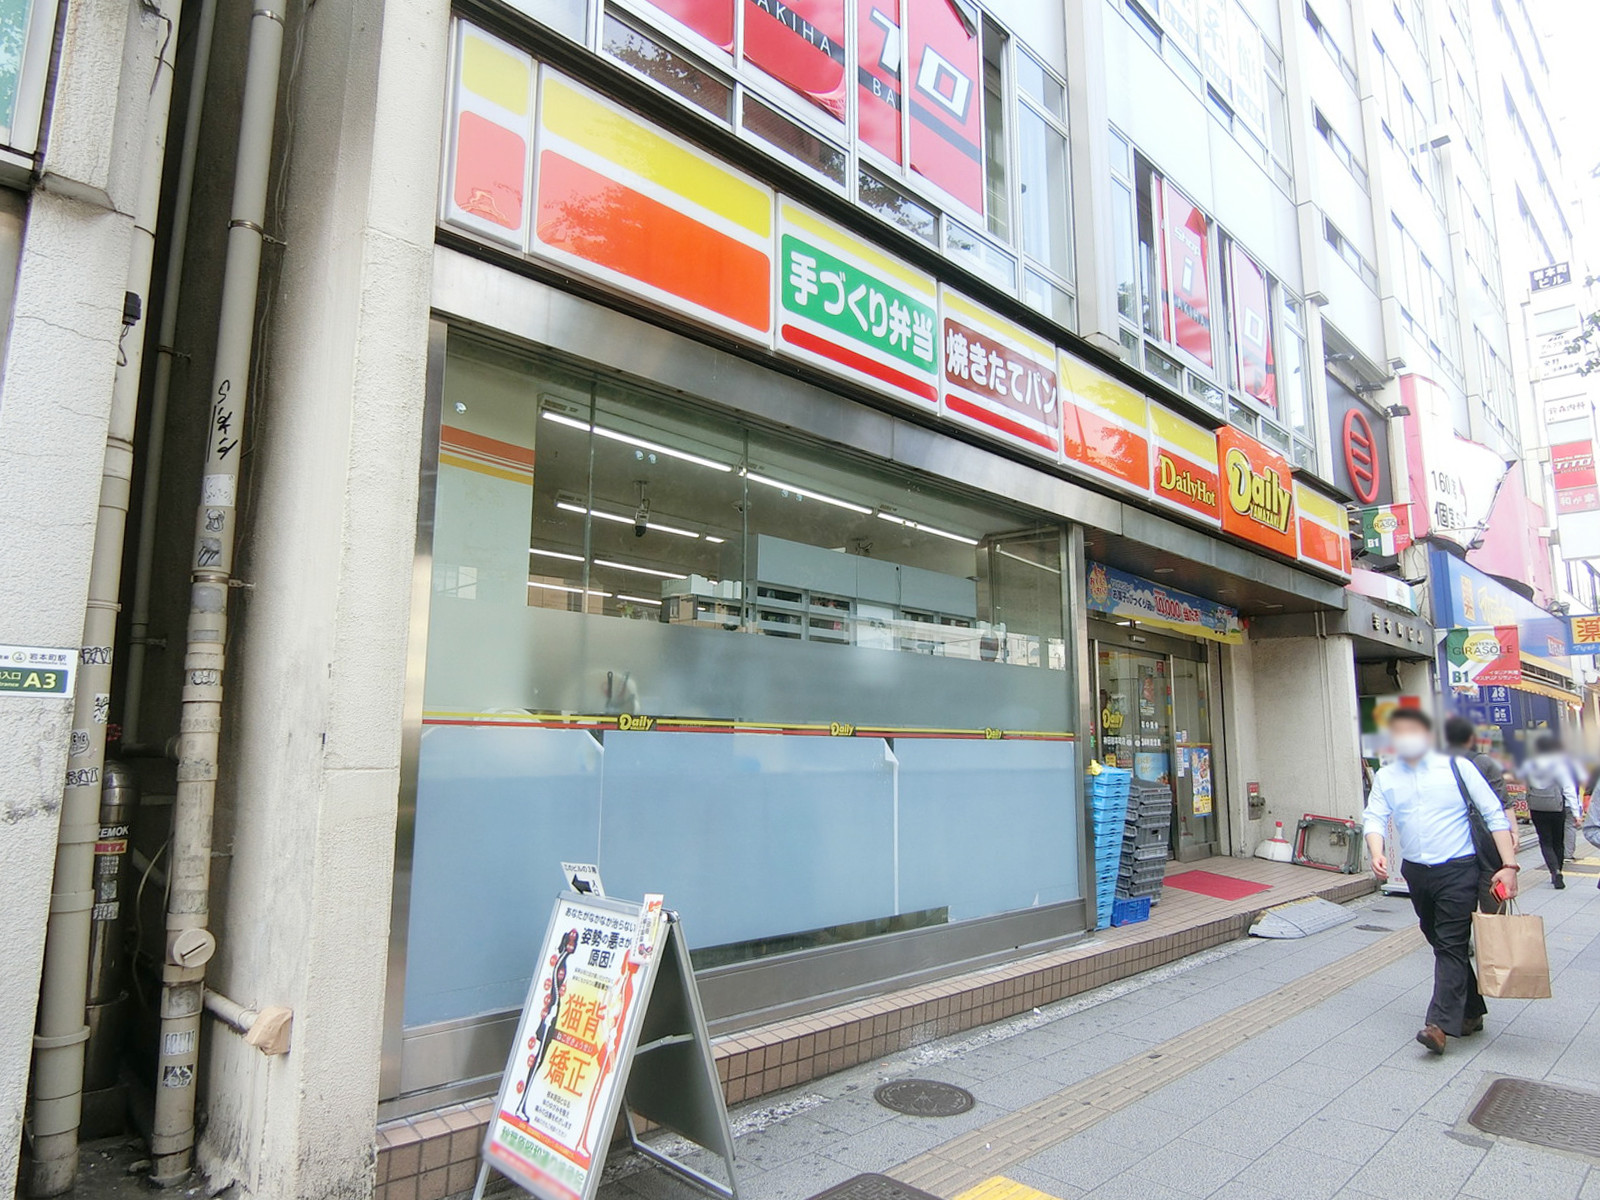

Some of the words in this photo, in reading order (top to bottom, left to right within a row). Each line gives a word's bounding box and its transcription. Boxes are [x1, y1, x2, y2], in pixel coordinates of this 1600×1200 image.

[790, 251, 933, 363] 手づくり弁当
[947, 327, 1057, 415] 焼きたてパン
[1159, 455, 1216, 507] DailyHot
[1226, 448, 1292, 533] Daily
[1367, 538, 1379, 548] B1
[30, 653, 67, 661] 岩本町駅
[1452, 644, 1513, 656] GIRASOLE
[0, 672, 21, 680] 入口
[23, 672, 57, 689] A3
[1452, 670, 1469, 683] B1
[619, 713, 654, 731] Daily
[829, 722, 855, 737] Daily
[565, 907, 636, 932] あなたがなかなか治らない
[581, 927, 632, 950] 姿勢の悪さが
[561, 993, 607, 1041] 猫背
[543, 1048, 591, 1098] 矯正
